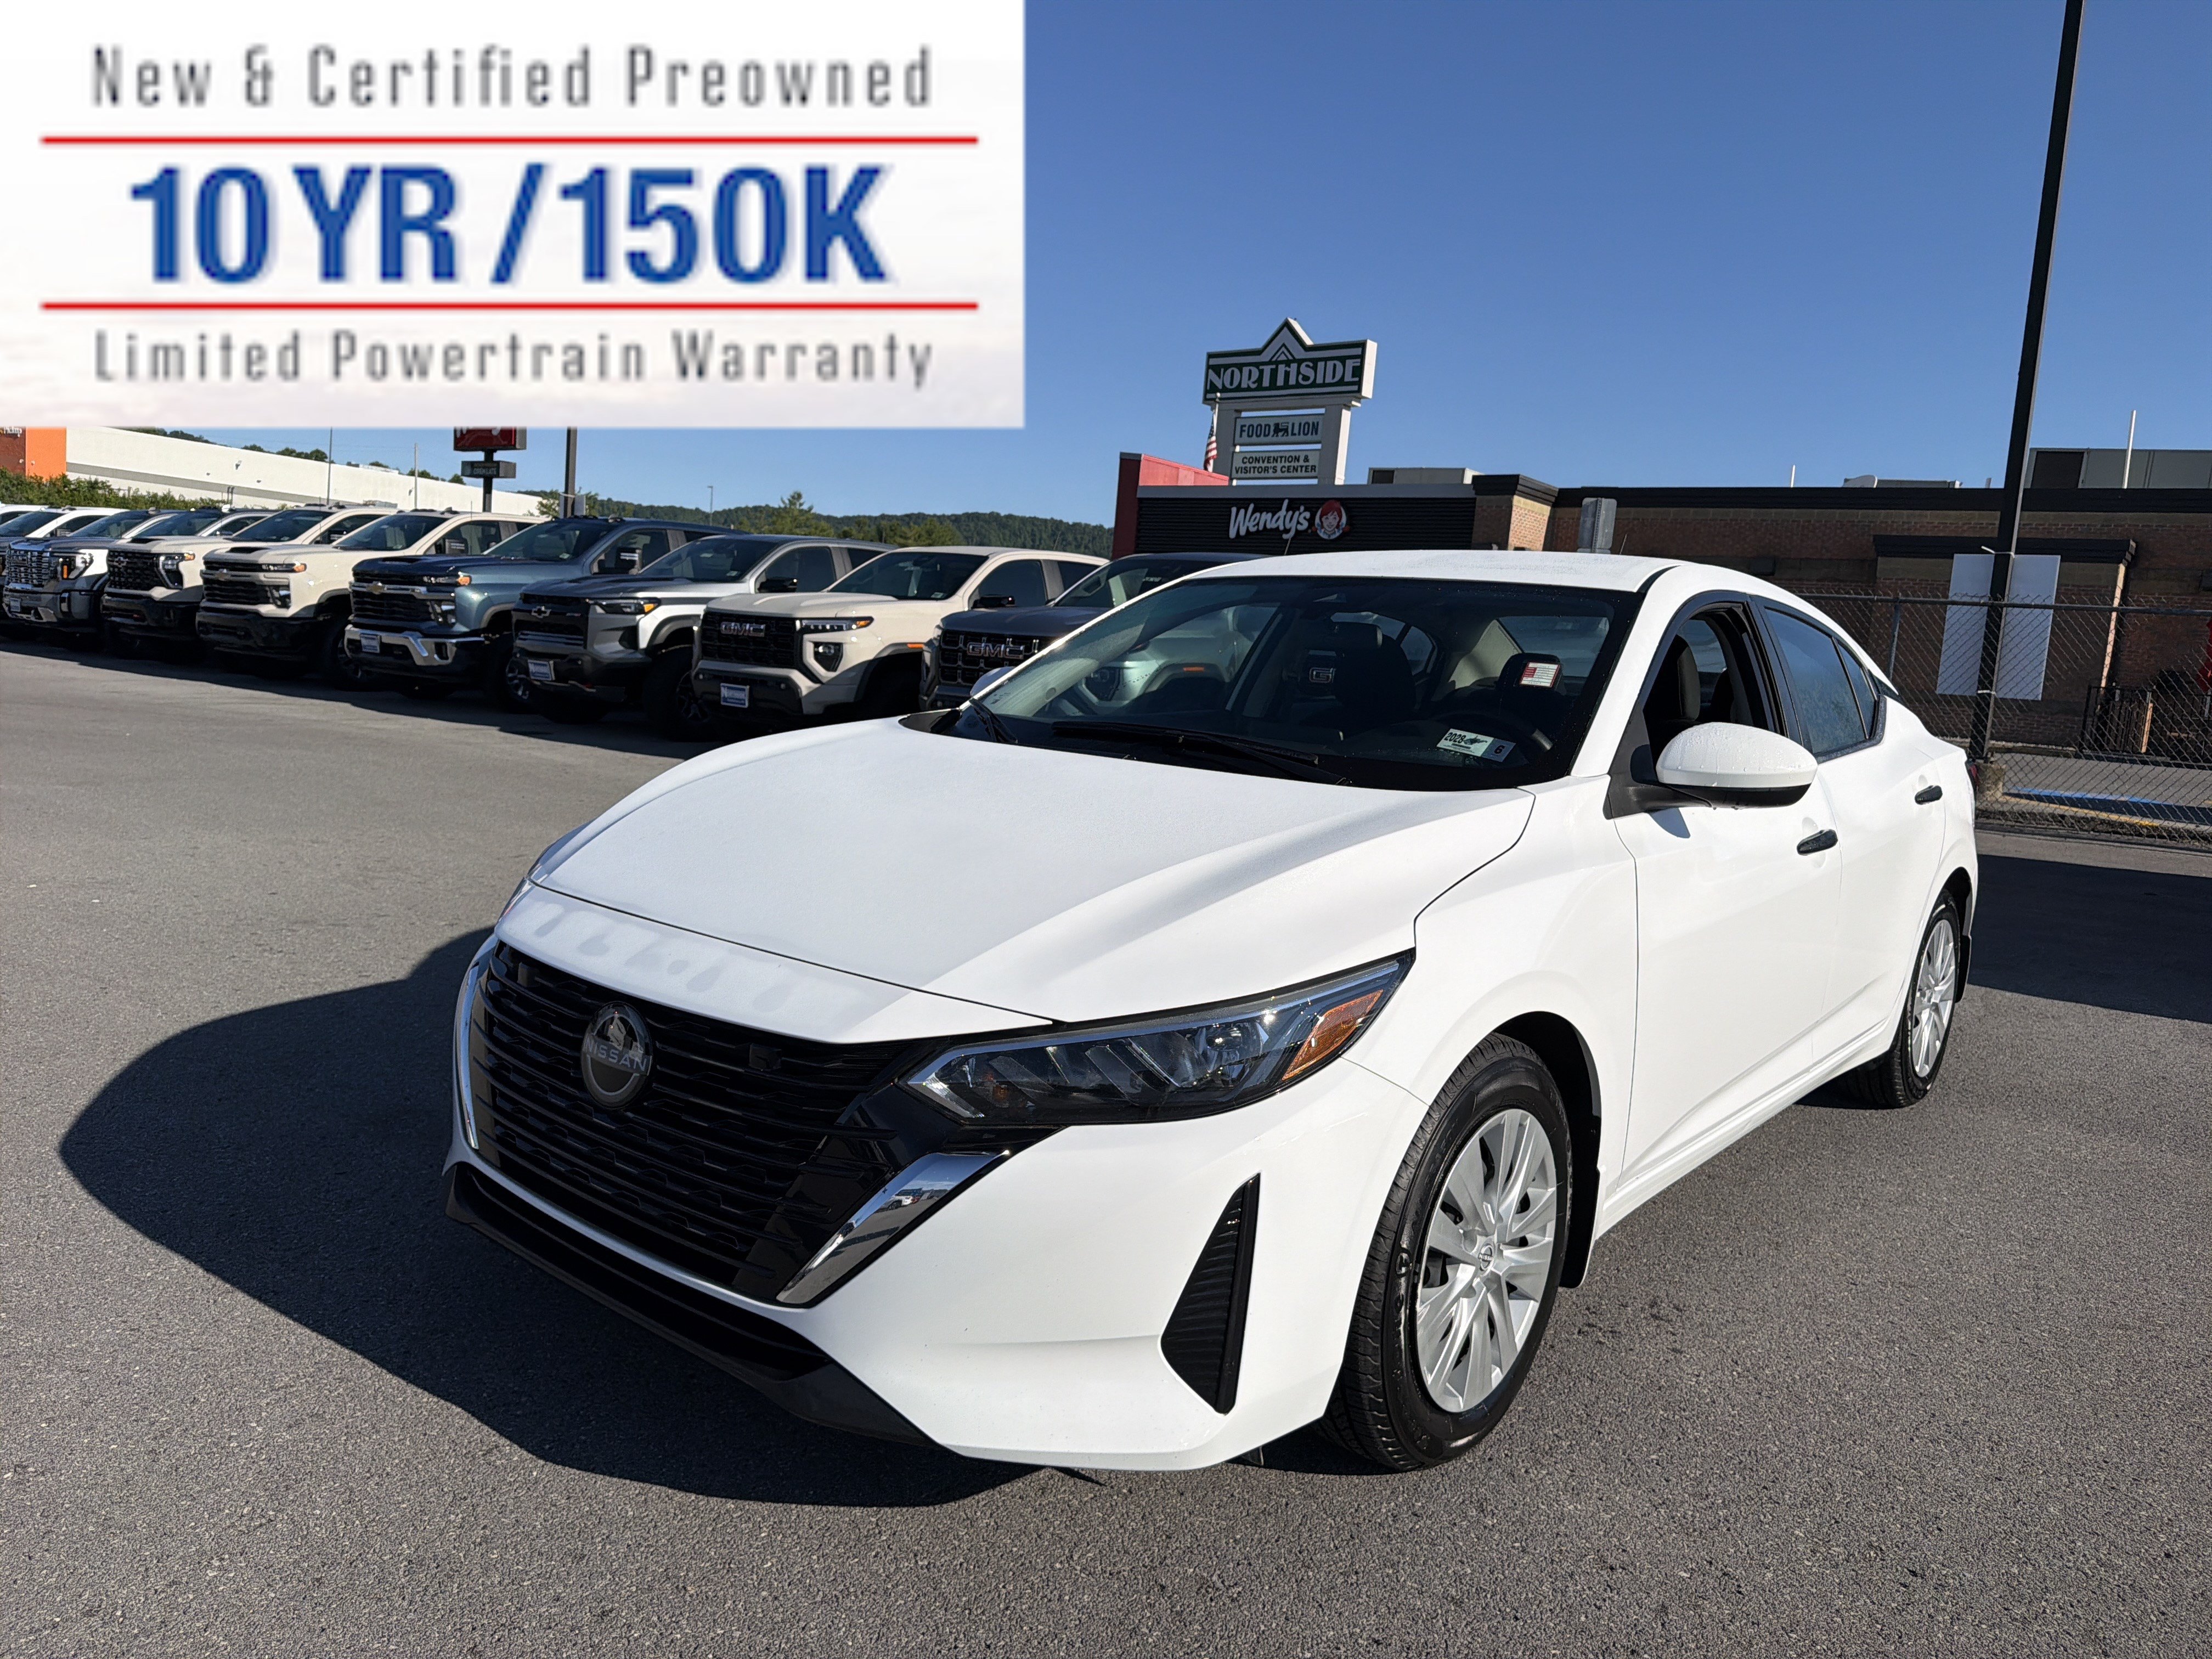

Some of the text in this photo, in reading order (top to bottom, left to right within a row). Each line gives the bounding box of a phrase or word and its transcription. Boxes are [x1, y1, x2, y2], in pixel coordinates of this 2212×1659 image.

[1207, 359, 1361, 390] NORTHSIDE
[1239, 421, 1319, 438] FOOD LION
[1242, 455, 1310, 465] CONVENTION &
[1234, 465, 1317, 474] VISITOR'S CENTER
[1229, 499, 1311, 539] Wendy's
[720, 622, 766, 637] GMC
[967, 641, 1024, 659] GMC
[1443, 732, 1466, 744] 2028
[1493, 744, 1506, 754] 6
[585, 1037, 647, 1071] NISSAN
